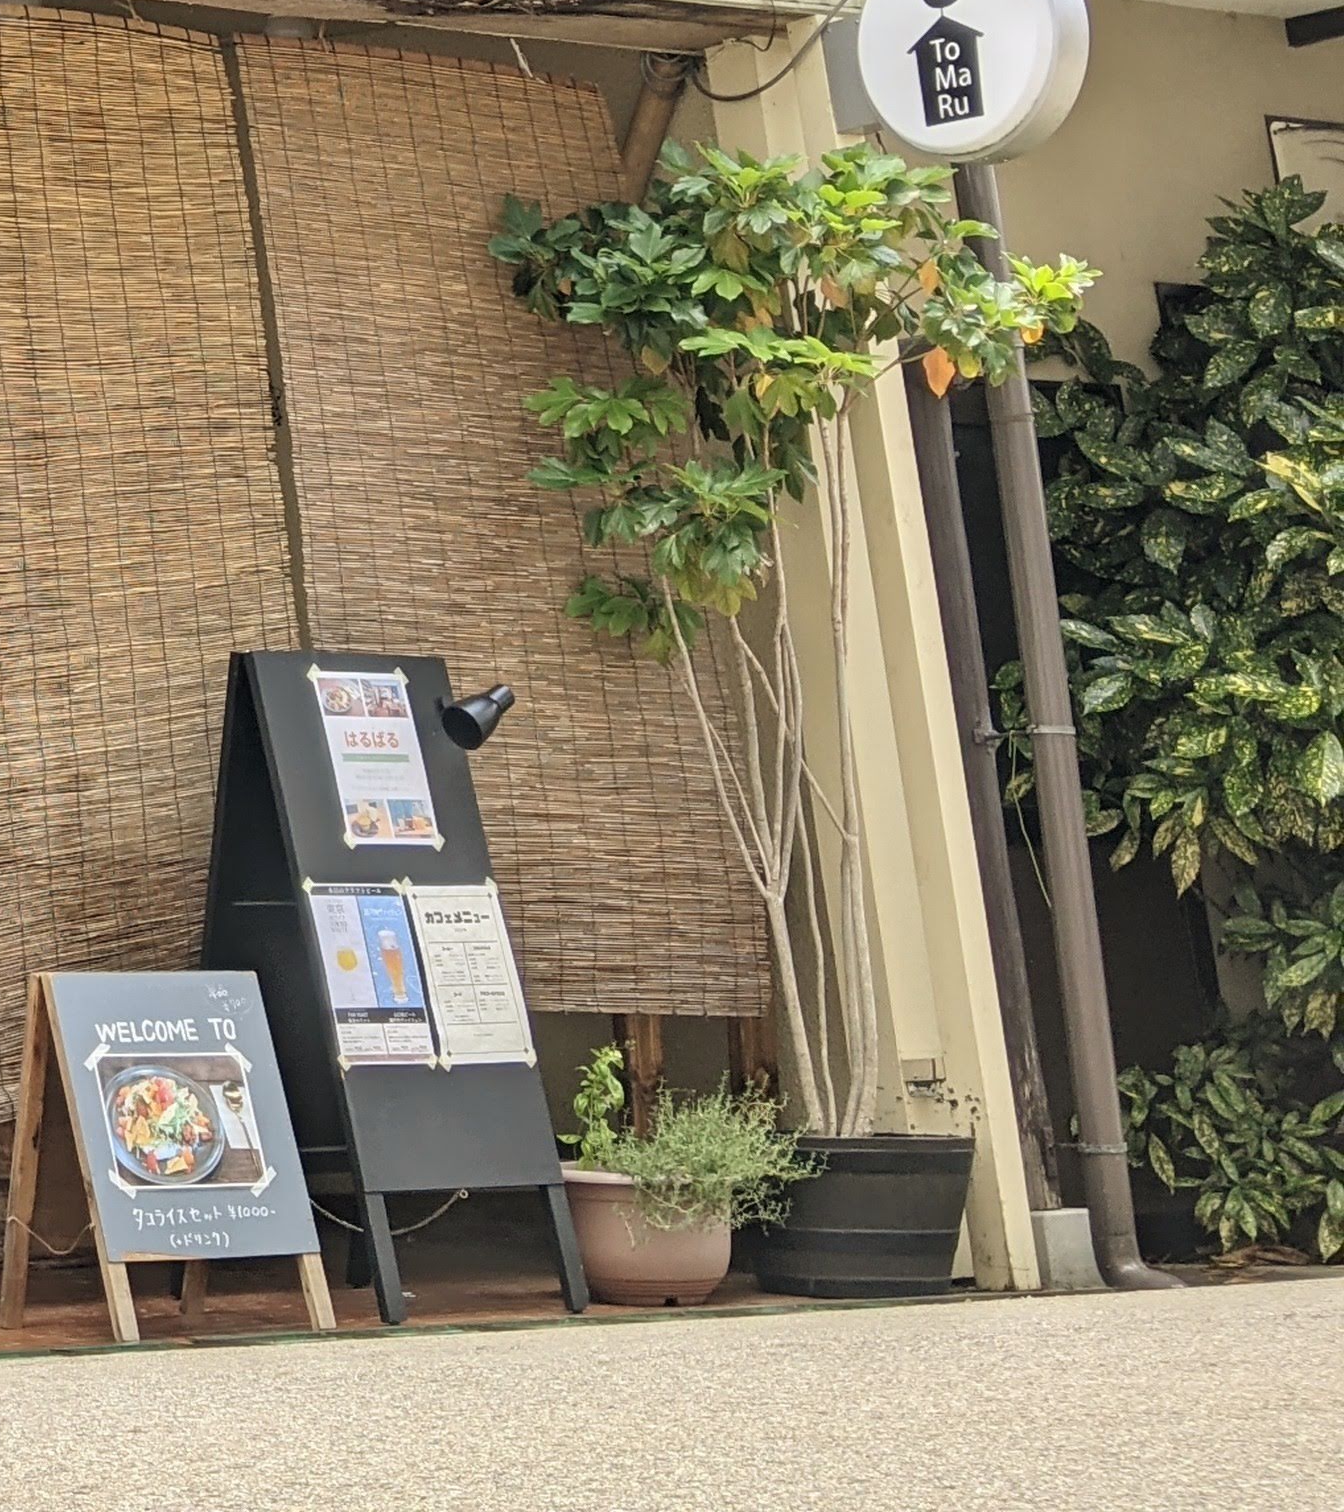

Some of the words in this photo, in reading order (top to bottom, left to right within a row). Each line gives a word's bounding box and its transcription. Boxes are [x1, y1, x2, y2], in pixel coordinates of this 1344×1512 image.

[929, 38, 960, 63] To
[934, 65, 972, 91] Ma
[938, 94, 969, 119] Ru
[424, 910, 490, 925] カフェメニュー
[95, 1019, 199, 1044] WELCOME
[208, 1017, 237, 1040] TO
